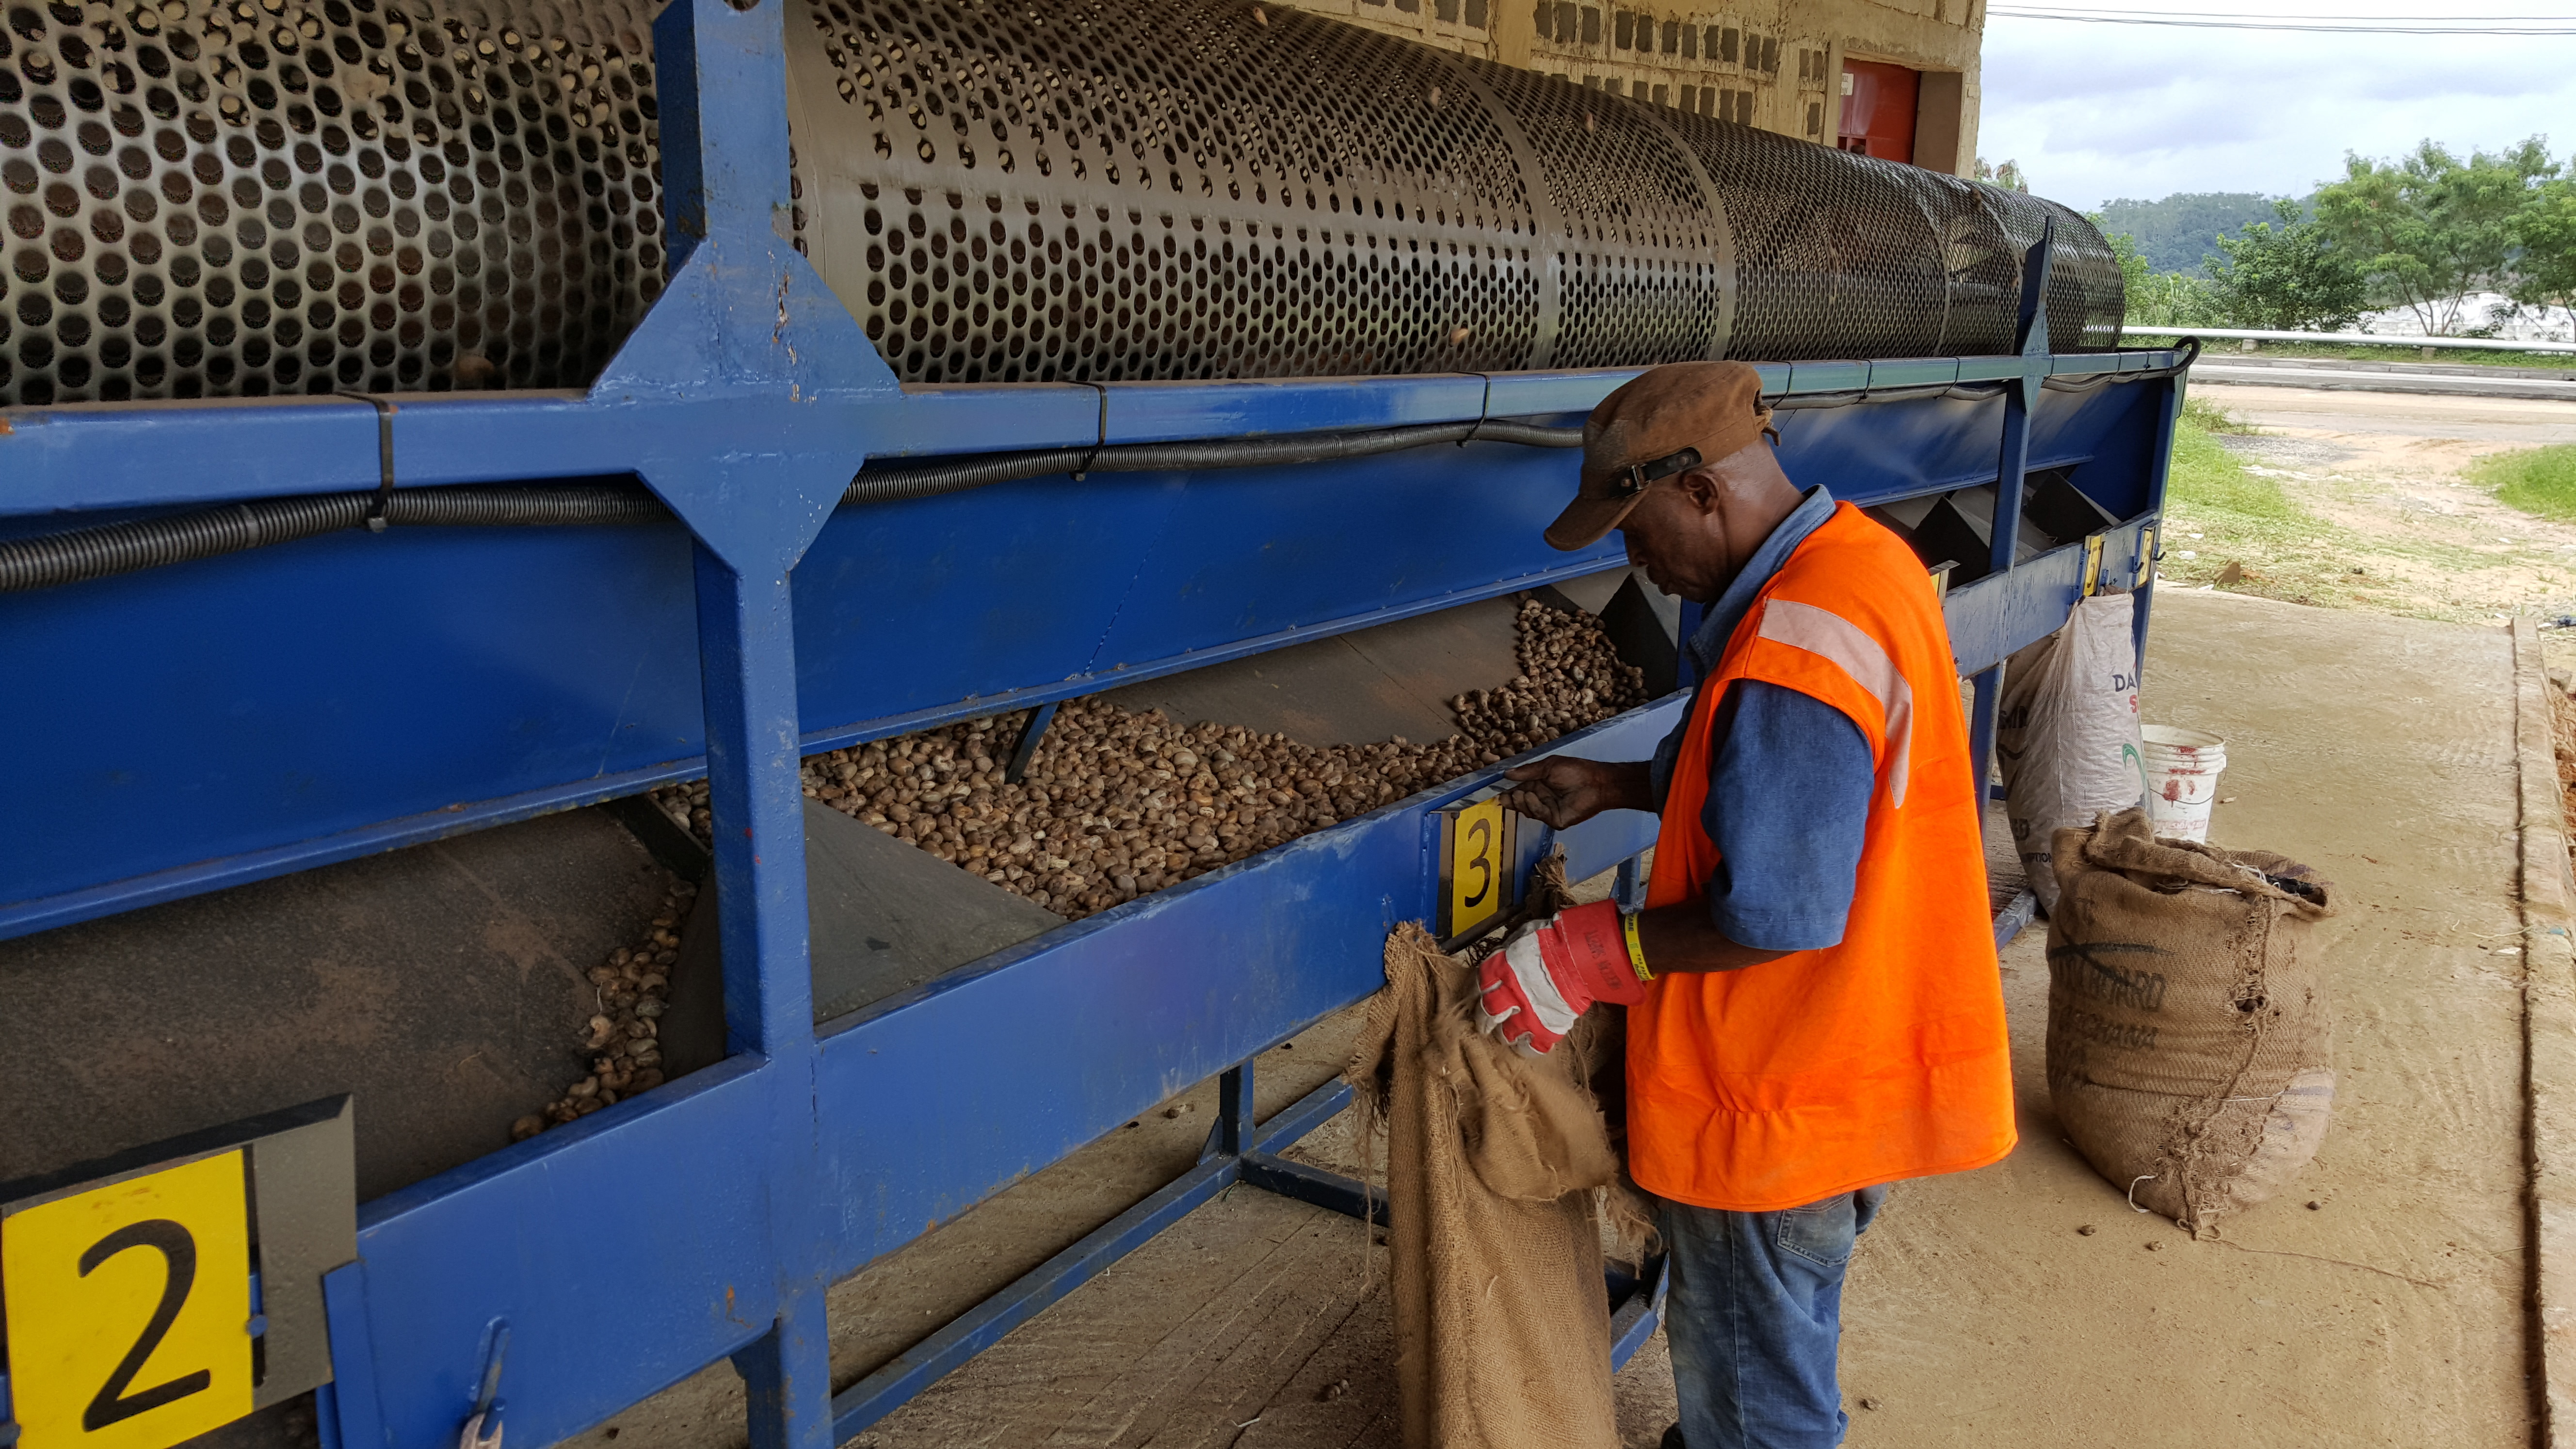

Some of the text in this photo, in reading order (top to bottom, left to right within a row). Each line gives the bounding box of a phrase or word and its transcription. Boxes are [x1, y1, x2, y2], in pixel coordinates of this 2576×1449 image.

[2087, 546, 2097, 589] 5
[1464, 818, 1491, 908] 3
[78, 1218, 210, 1433] 2
